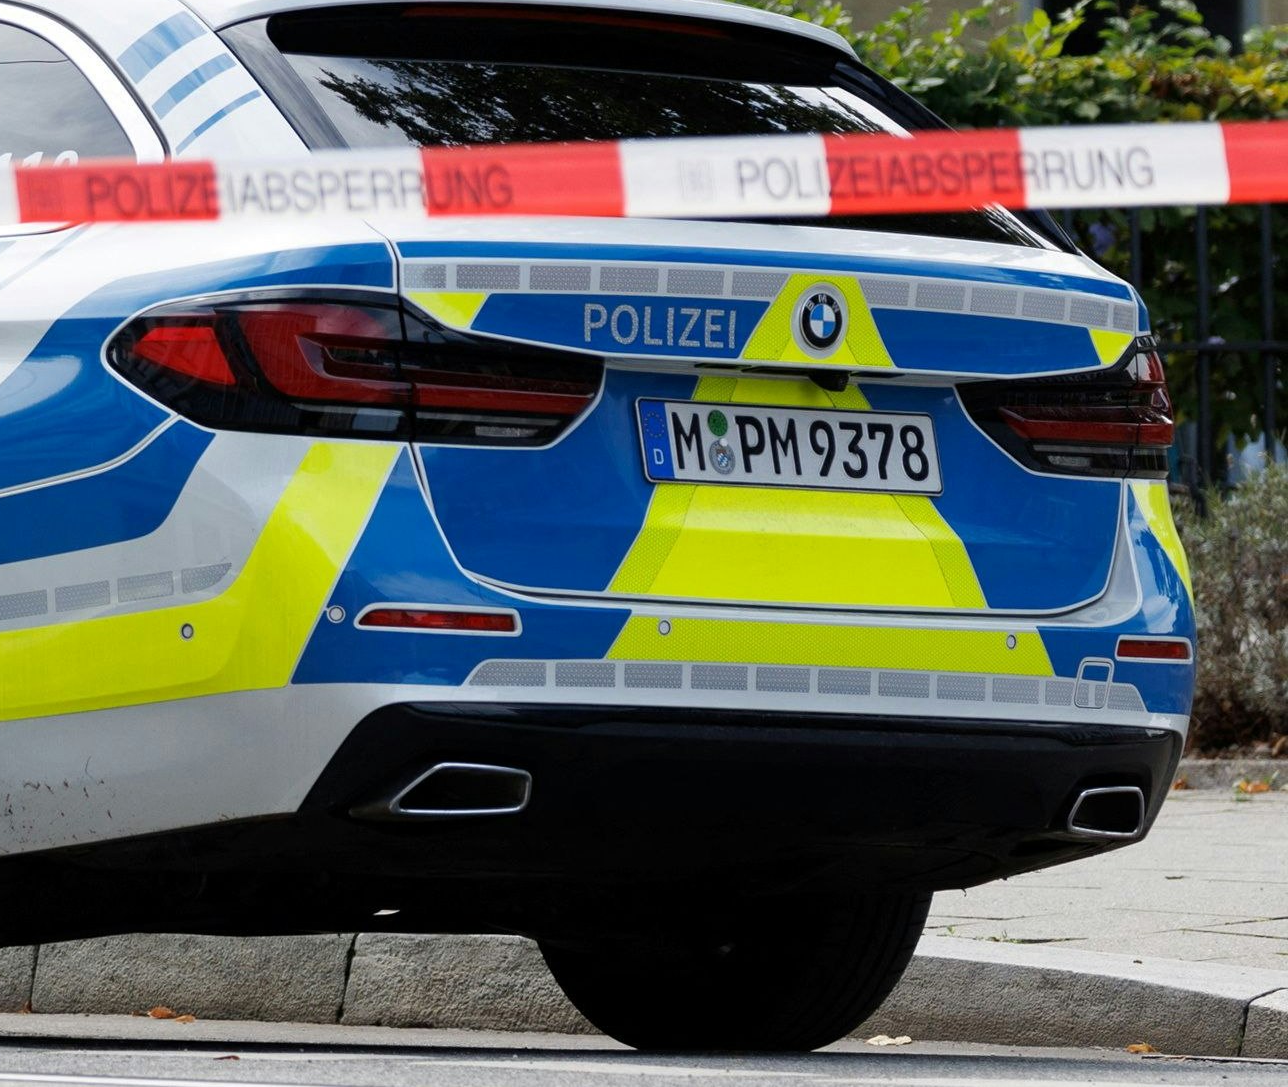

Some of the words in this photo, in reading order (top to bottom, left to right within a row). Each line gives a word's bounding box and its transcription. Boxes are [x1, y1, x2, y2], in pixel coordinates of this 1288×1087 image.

[85, 166, 513, 215] POLIZEIABSPERRUNG
[736, 145, 1154, 200] POLIZEIABSPERRUNG
[584, 303, 737, 350] POLIZEI
[653, 448, 664, 466] D
[671, 412, 706, 471] M
[809, 420, 929, 482] 9378
